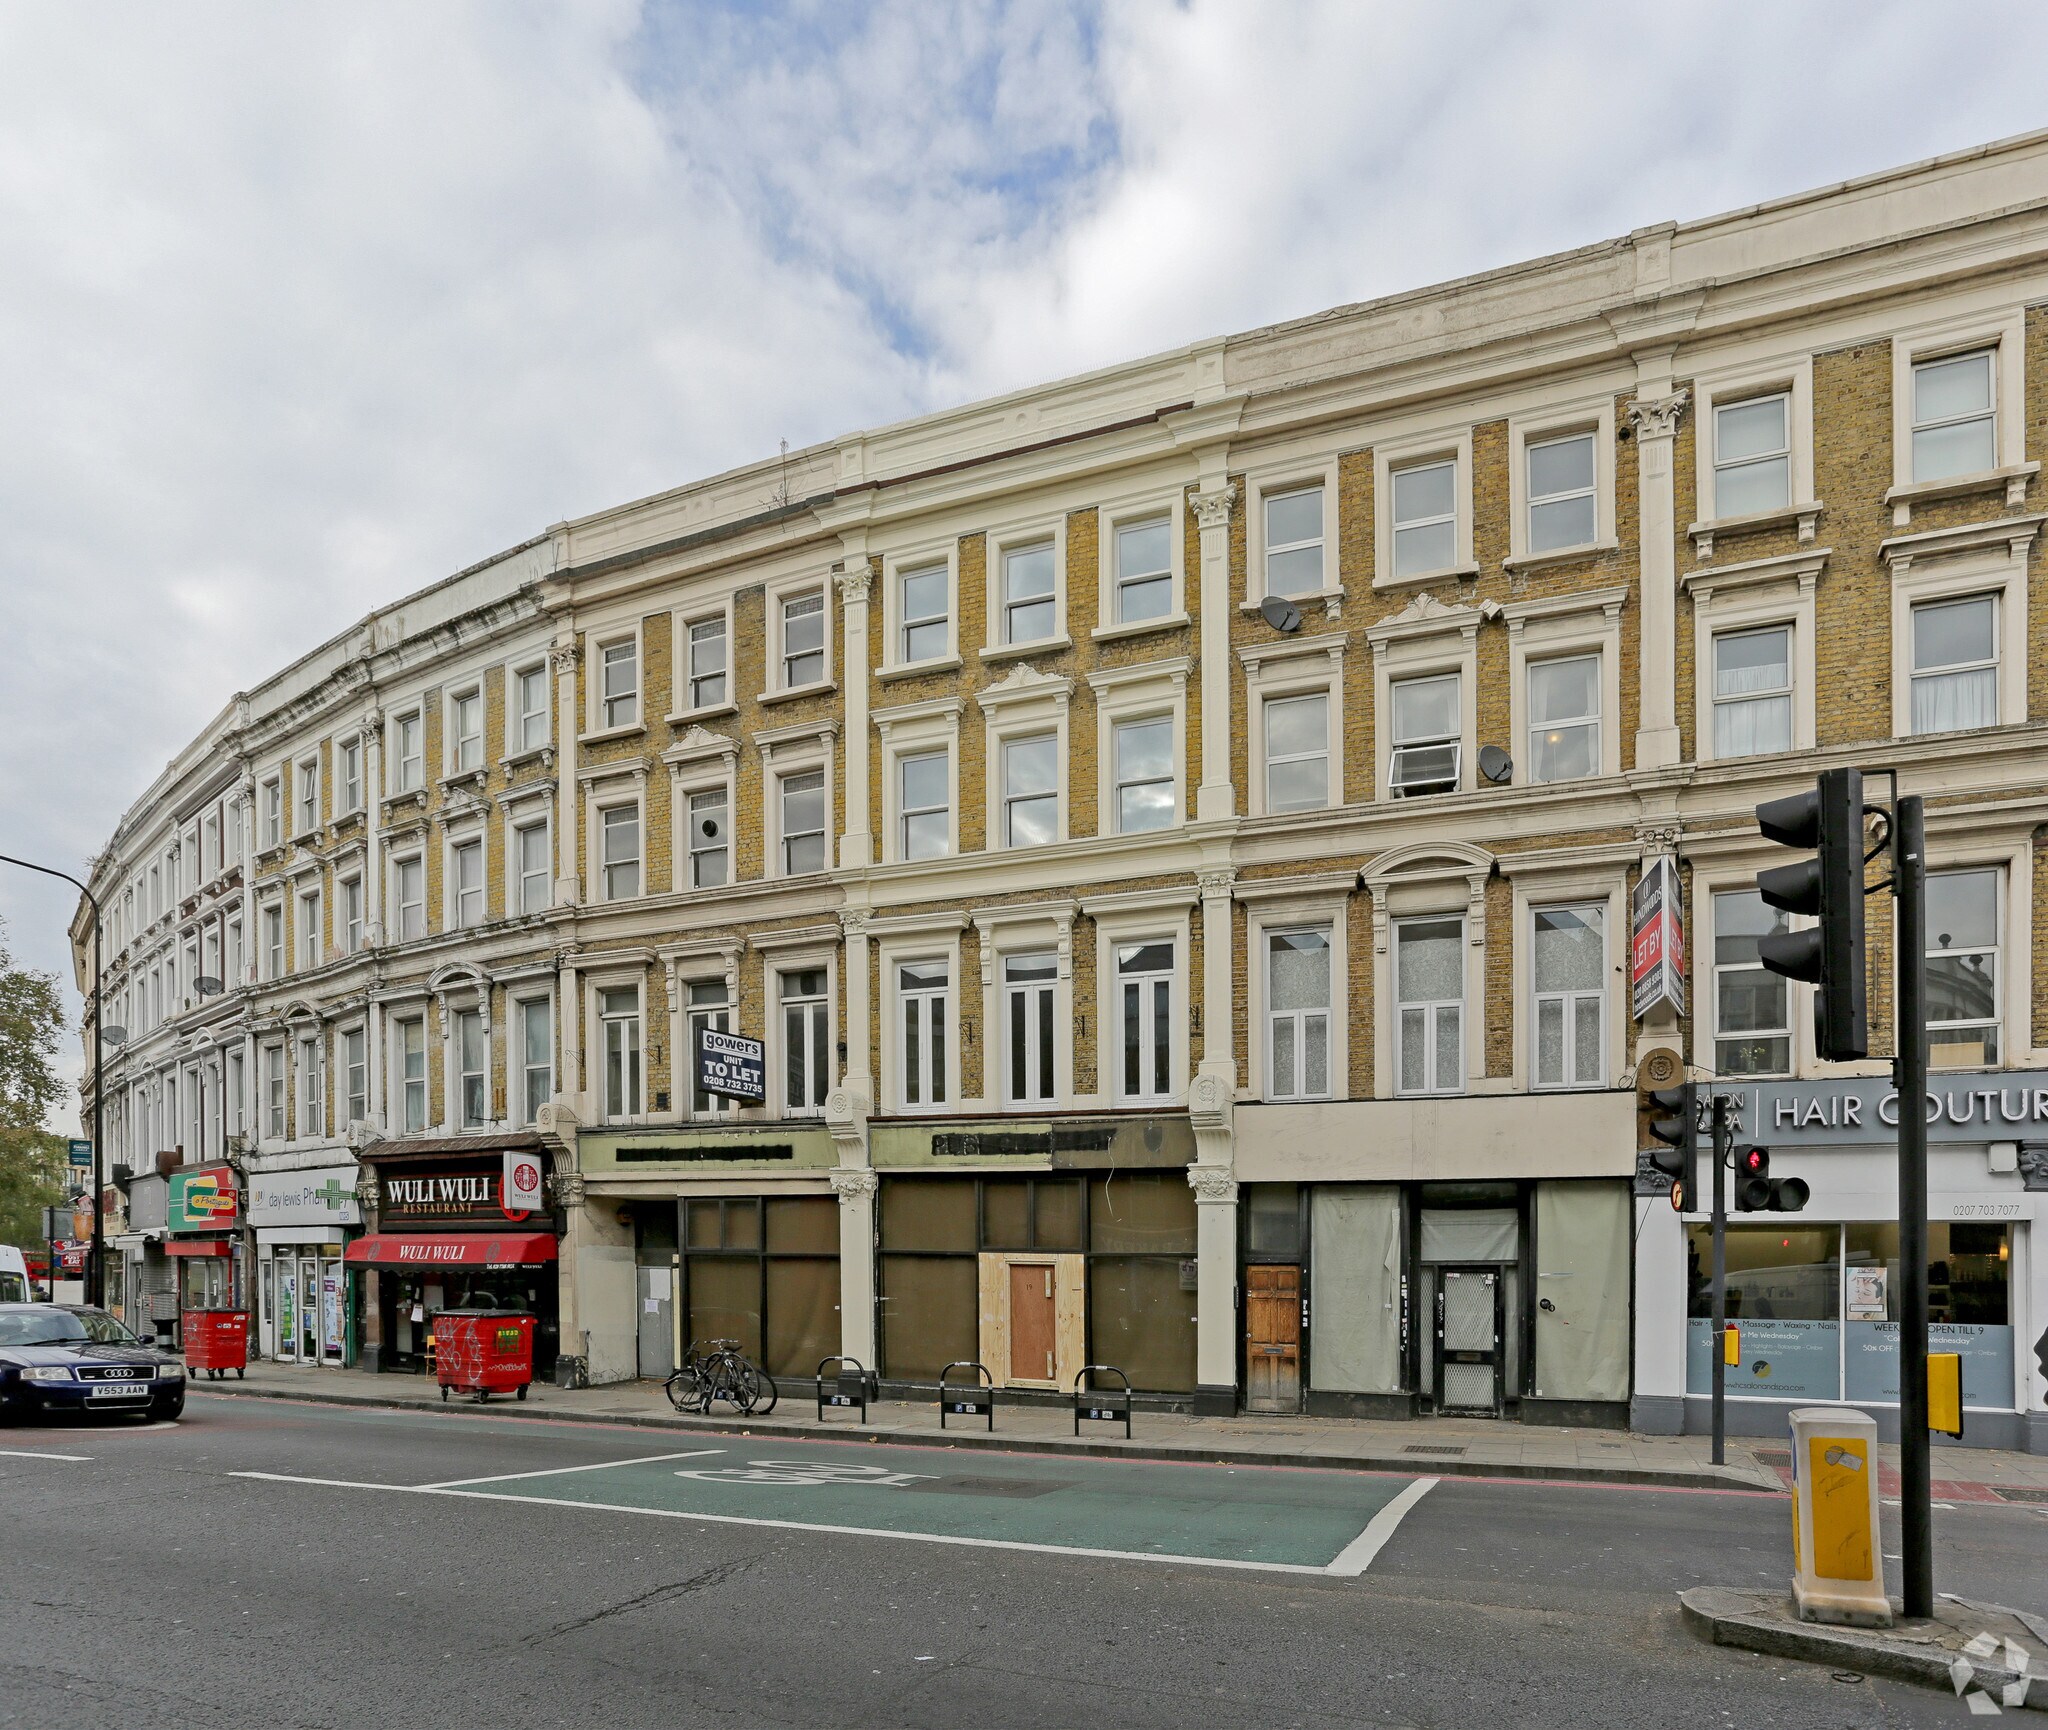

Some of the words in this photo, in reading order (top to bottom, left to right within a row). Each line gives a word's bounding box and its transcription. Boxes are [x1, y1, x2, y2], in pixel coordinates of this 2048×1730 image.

[1634, 939, 1648, 970] LET
[1650, 925, 1661, 956] BY
[706, 1034, 759, 1055] gowers
[723, 1055, 743, 1066] UNIT
[704, 1060, 728, 1077] TO
[732, 1065, 761, 1083] LET
[703, 1075, 724, 1086] 0208
[726, 1079, 741, 1089] 732
[743, 1082, 762, 1093] 3735
[1775, 1095, 1862, 1127] HAIR
[388, 1179, 435, 1203] WULI
[439, 1177, 490, 1202] WULI
[269, 1192, 281, 1210] day
[283, 1191, 301, 1207] lewis
[403, 1203, 473, 1214] RESTAURANT
[1953, 1205, 1976, 1216] 0207
[1978, 1205, 1995, 1216] 703
[1997, 1204, 2020, 1216] 7077
[400, 1245, 432, 1260] WULI
[433, 1245, 466, 1260] WULI
[1026, 1283, 1033, 1291] 19
[1742, 1320, 1776, 1329] Massage
[1783, 1321, 1811, 1330] Waxing
[1818, 1322, 1837, 1330] Nails
[1874, 1323, 1900, 1332] WEEK
[1928, 1324, 1955, 1334] OPEN
[1957, 1325, 1975, 1335] TILL
[1978, 1326, 1985, 1335] 9
[1748, 1331, 1758, 1339] Me
[1879, 1344, 1894, 1352] OFF
[97, 1386, 124, 1395] V553
[126, 1385, 145, 1394] AAN
